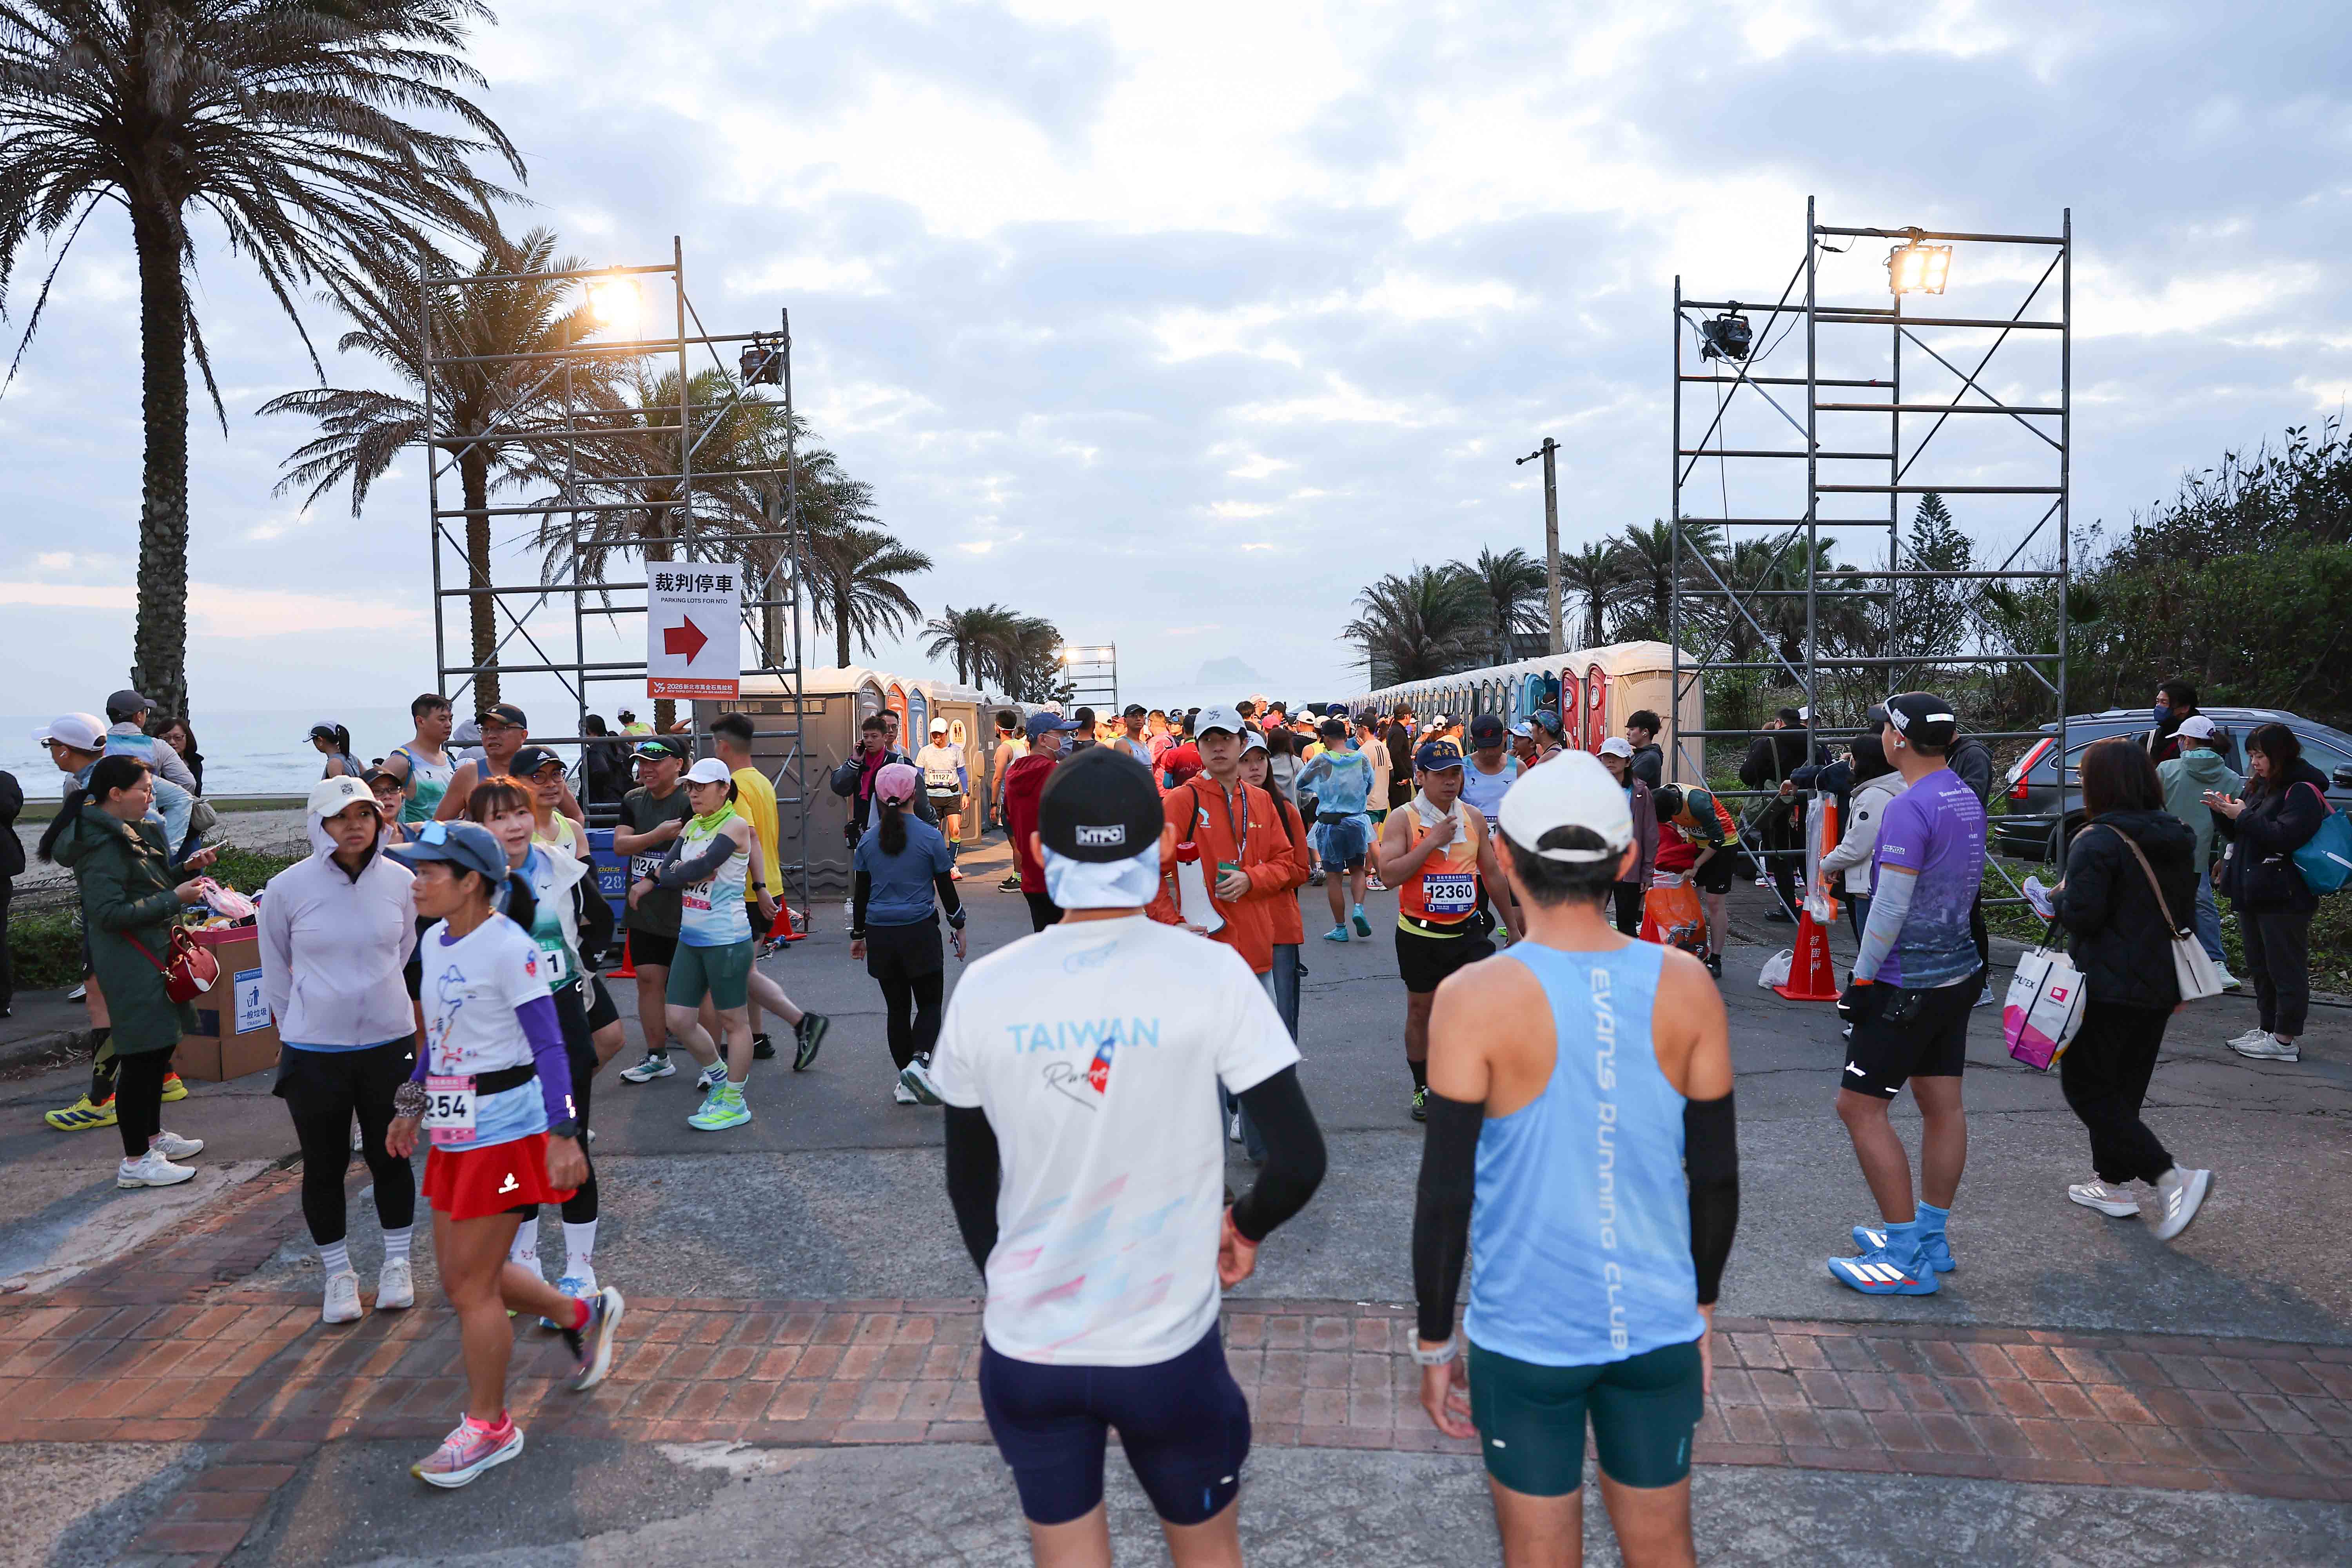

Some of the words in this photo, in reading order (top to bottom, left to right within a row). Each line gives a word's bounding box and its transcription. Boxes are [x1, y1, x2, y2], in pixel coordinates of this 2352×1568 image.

[655, 573, 733, 593] 裁判停車
[1427, 884, 1472, 898] 12360
[240, 1008, 267, 1020] 一般垃圾
[1005, 1017, 1160, 1054] TAIWAN
[1597, 1102, 1617, 1249] RUNNING
[1604, 1261, 1629, 1351] CLUB
